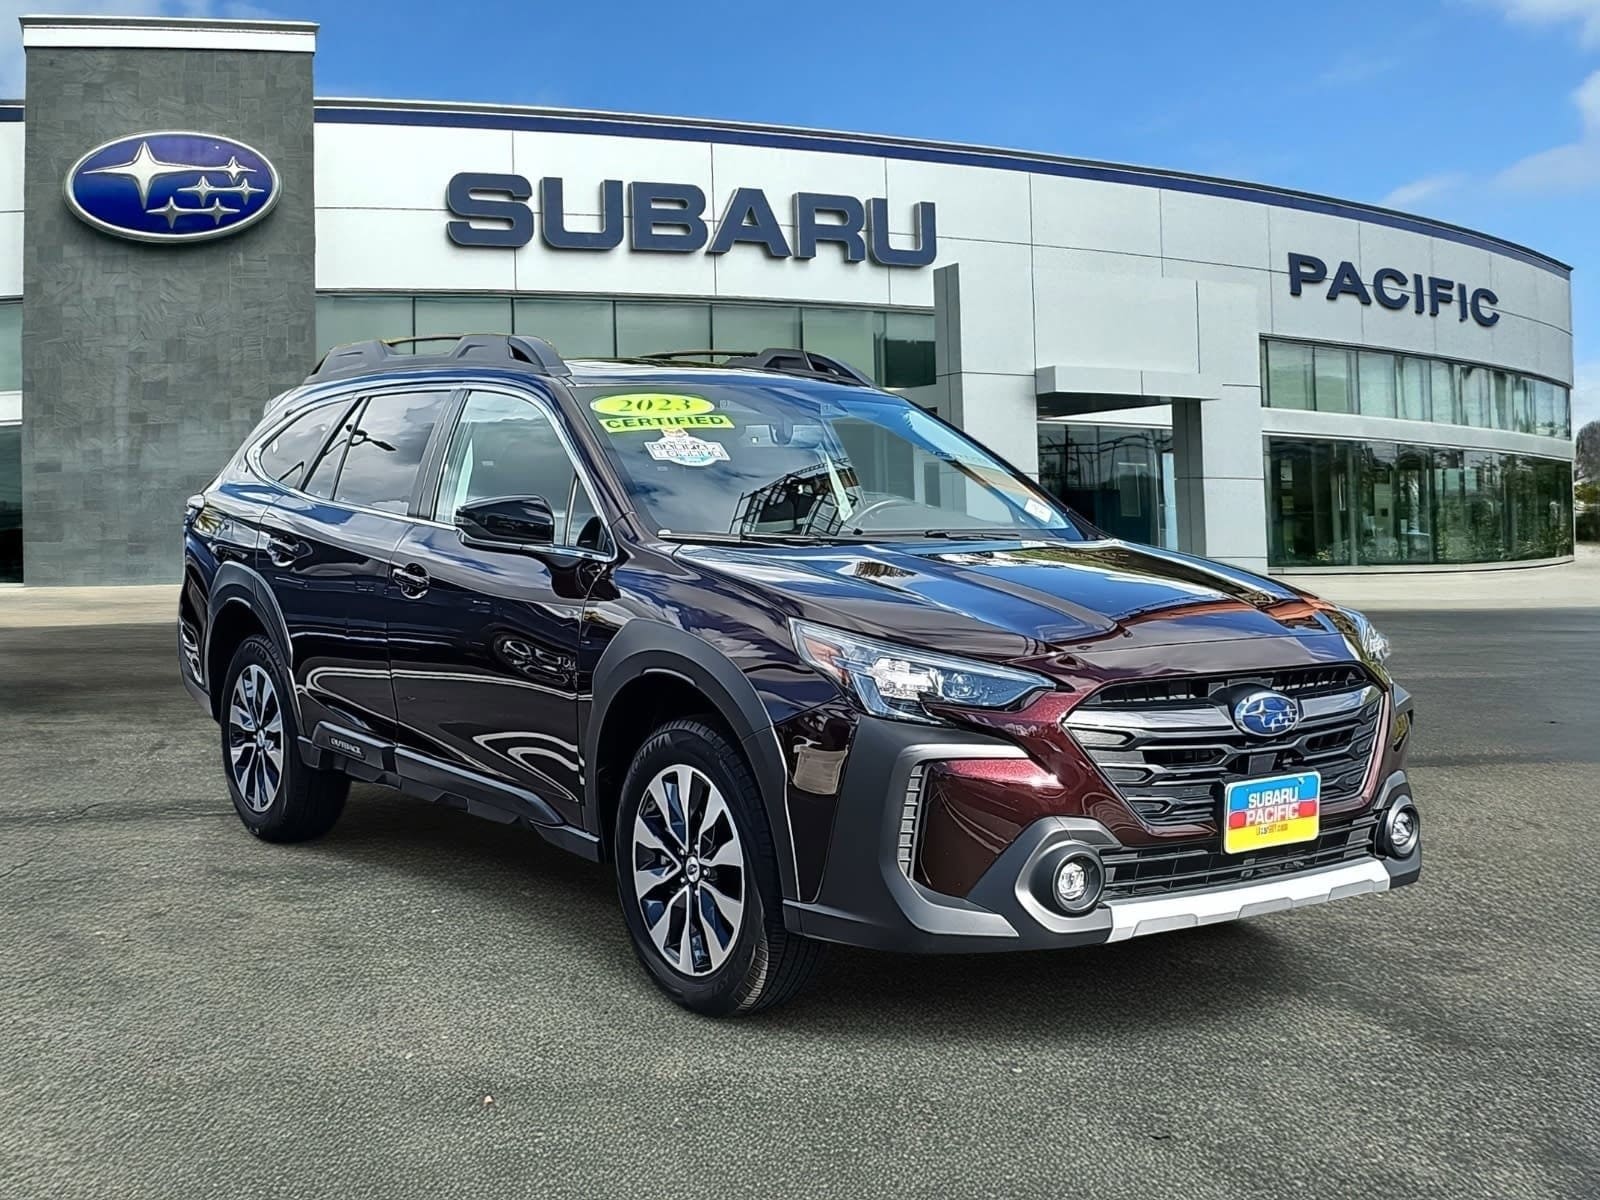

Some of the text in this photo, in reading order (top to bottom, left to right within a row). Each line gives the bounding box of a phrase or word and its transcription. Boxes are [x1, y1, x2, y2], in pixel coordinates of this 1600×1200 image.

[447, 172, 937, 267] SUBARU
[1288, 252, 1500, 327] PACIFIC
[618, 399, 691, 412] 2023
[606, 416, 724, 429] CERTIFIED
[1248, 787, 1299, 809] SUBARU
[1245, 804, 1300, 826] PACIFIC
